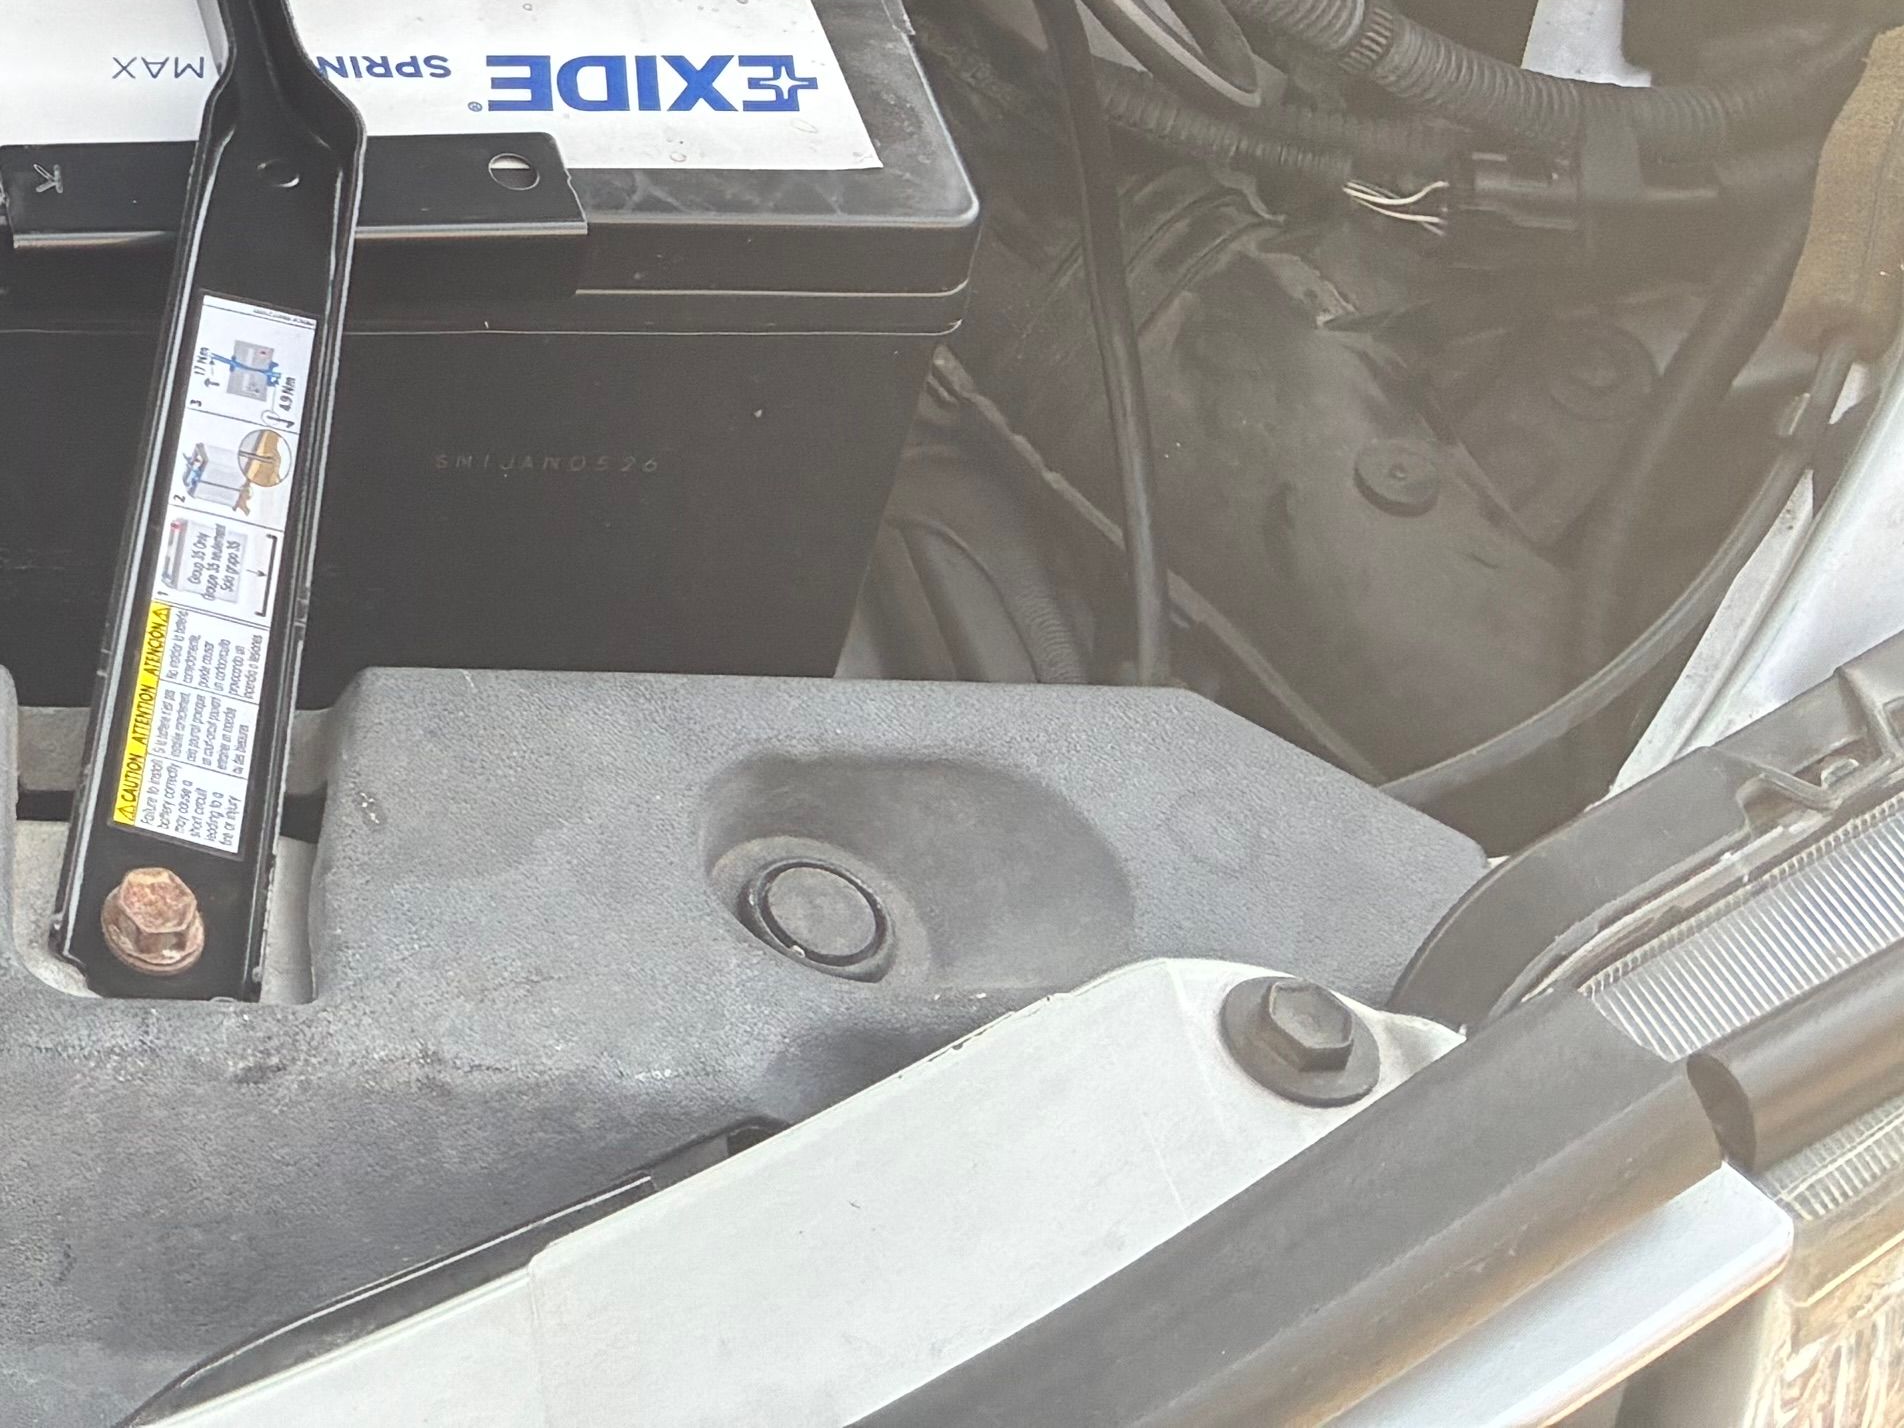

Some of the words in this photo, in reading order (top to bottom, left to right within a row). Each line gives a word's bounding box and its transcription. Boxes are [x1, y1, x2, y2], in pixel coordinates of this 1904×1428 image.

[111, 56, 204, 78] MAX
[309, 53, 450, 80] SPRIN
[130, 682, 155, 744] ATTENTION
[121, 751, 143, 802] CAUTION
